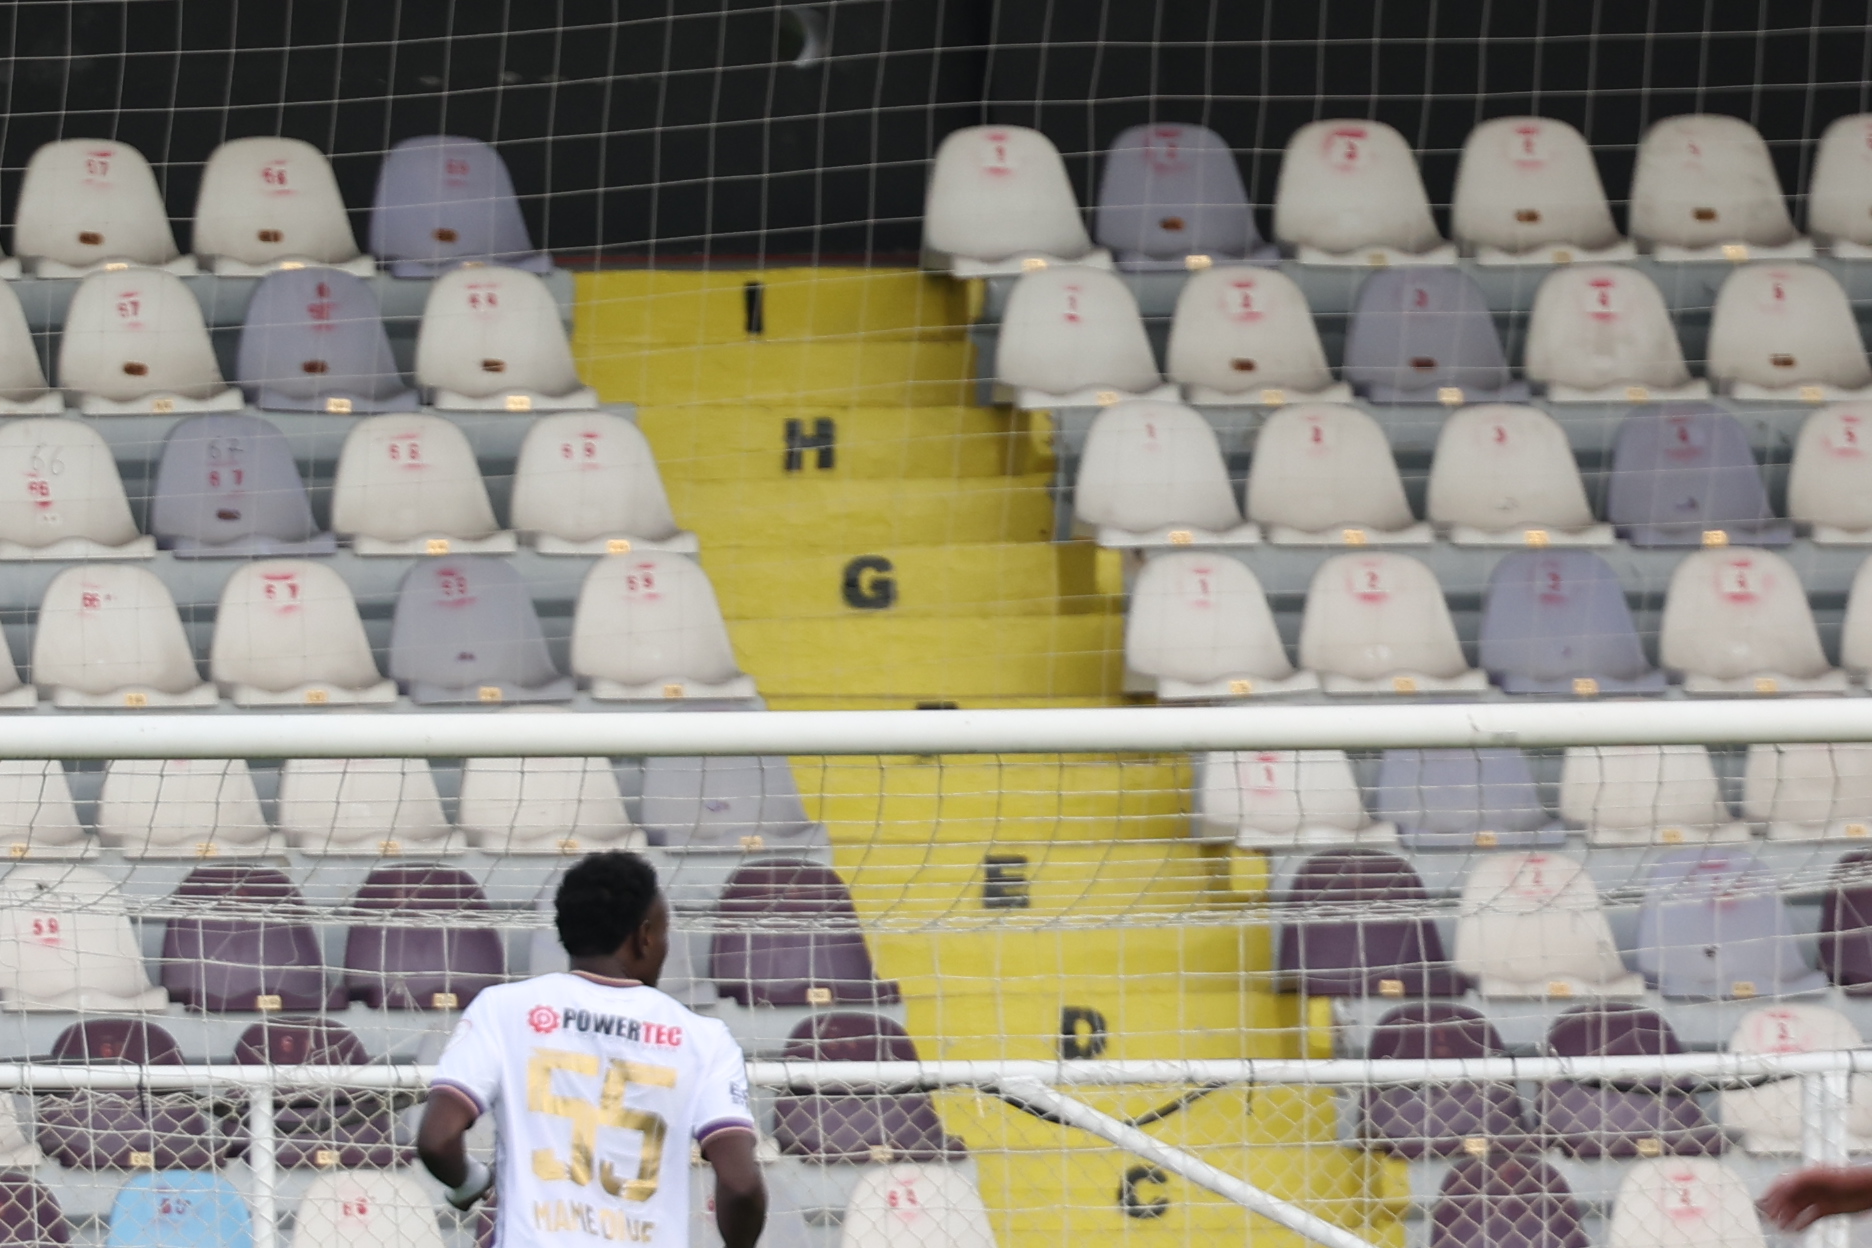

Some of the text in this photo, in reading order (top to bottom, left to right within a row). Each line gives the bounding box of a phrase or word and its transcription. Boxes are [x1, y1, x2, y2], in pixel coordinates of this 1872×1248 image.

[784, 417, 835, 471] H
[840, 554, 899, 610] G
[983, 853, 1029, 909] E
[562, 1007, 683, 1047] POWERTEC
[1060, 1007, 1107, 1060] D
[528, 1047, 677, 1203] 55
[1118, 1164, 1170, 1218] C
